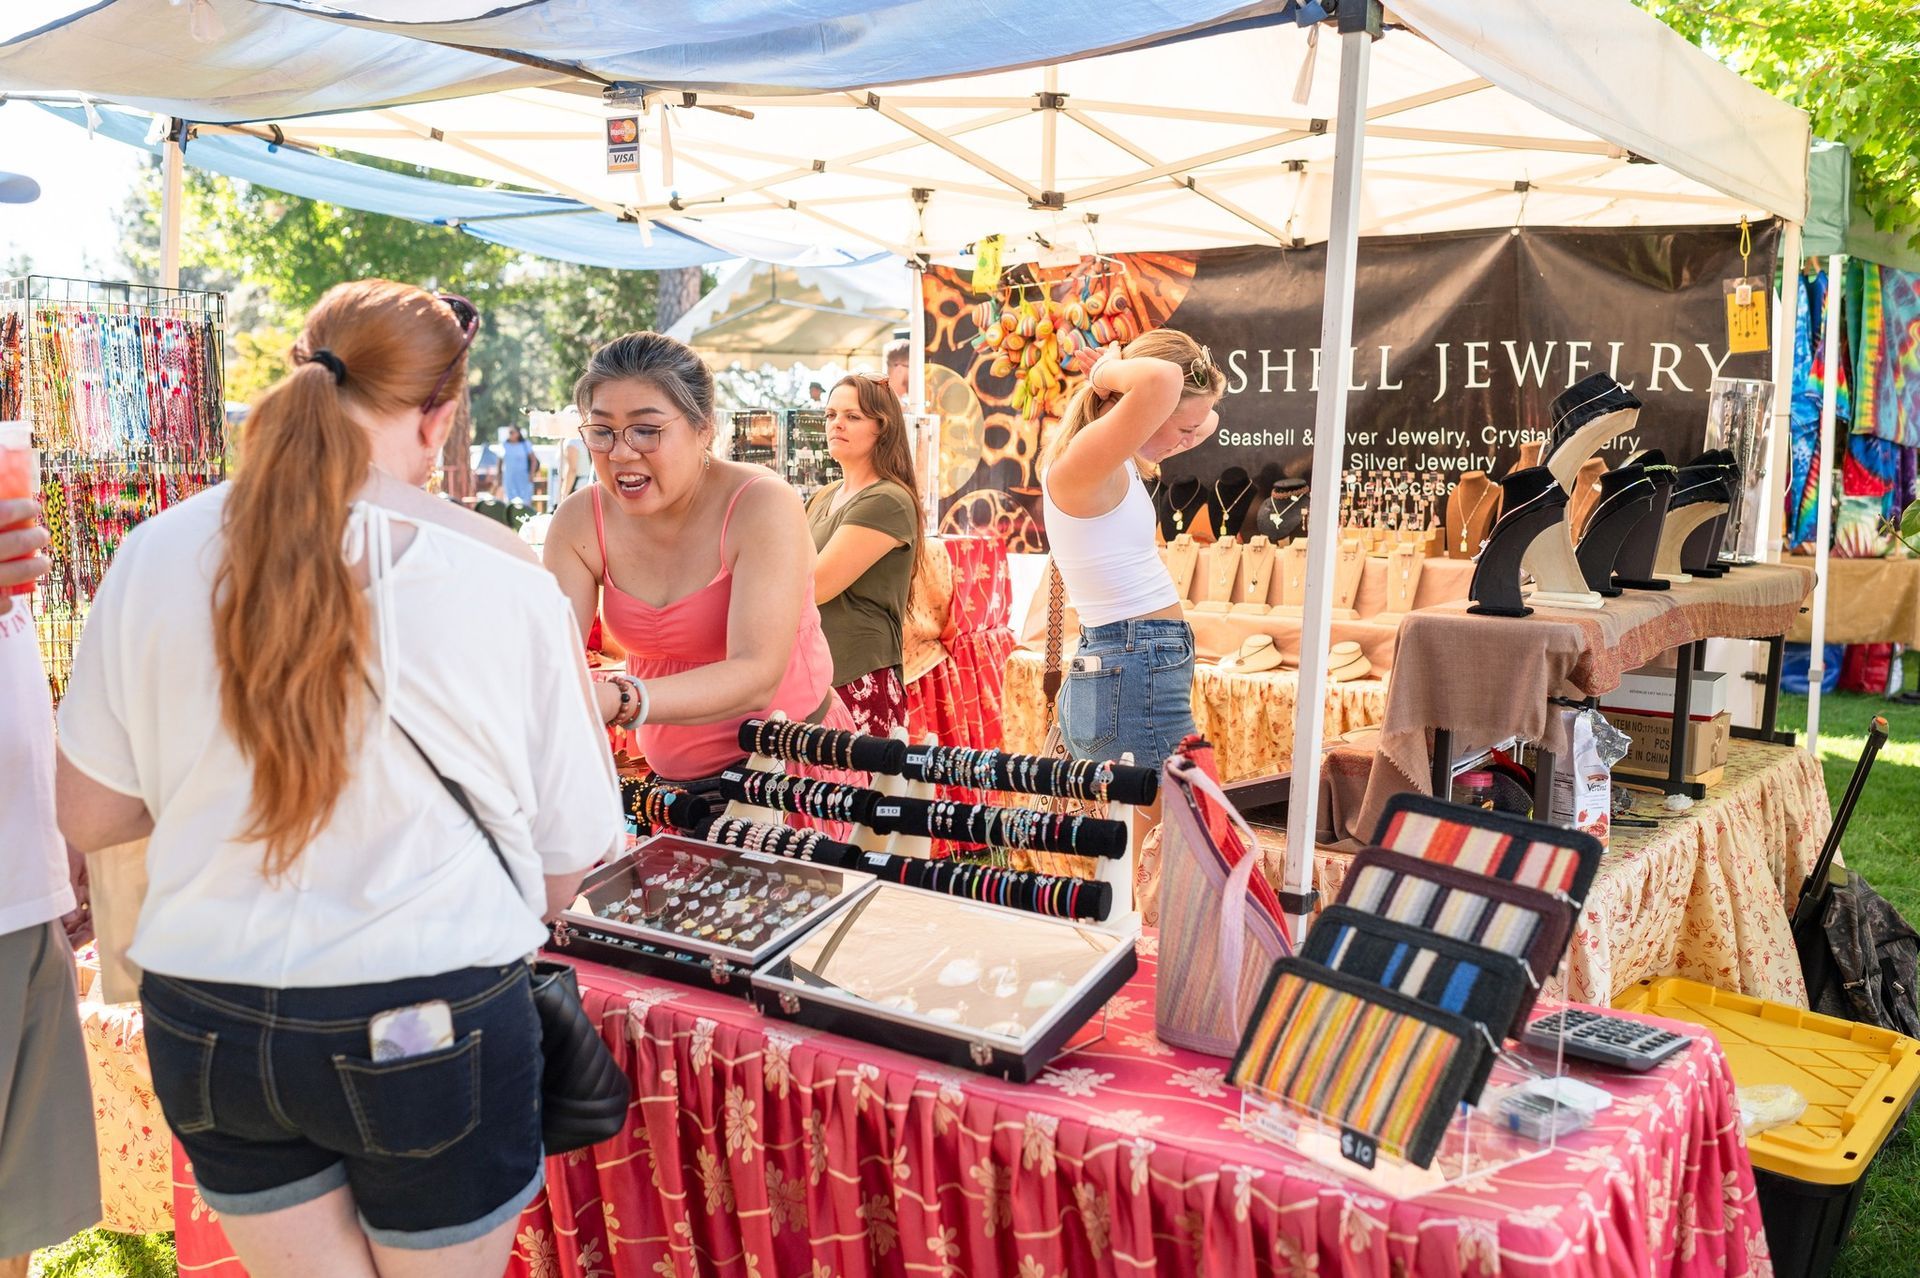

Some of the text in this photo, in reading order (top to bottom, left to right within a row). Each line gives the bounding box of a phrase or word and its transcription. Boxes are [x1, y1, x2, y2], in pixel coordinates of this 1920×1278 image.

[613, 153, 634, 163] VISA
[1433, 340, 1732, 402] JEWELRY
[1218, 428, 1294, 446] Seashell
[1302, 429, 1314, 446] &
[1386, 427, 1470, 449] Jewelry,
[1350, 452, 1497, 475] Silver Jewelry
[1655, 738, 1670, 751] PCS
[1635, 750, 1643, 761] IN
[1646, 751, 1669, 764] CHINA
[1341, 1133, 1372, 1163] $10
